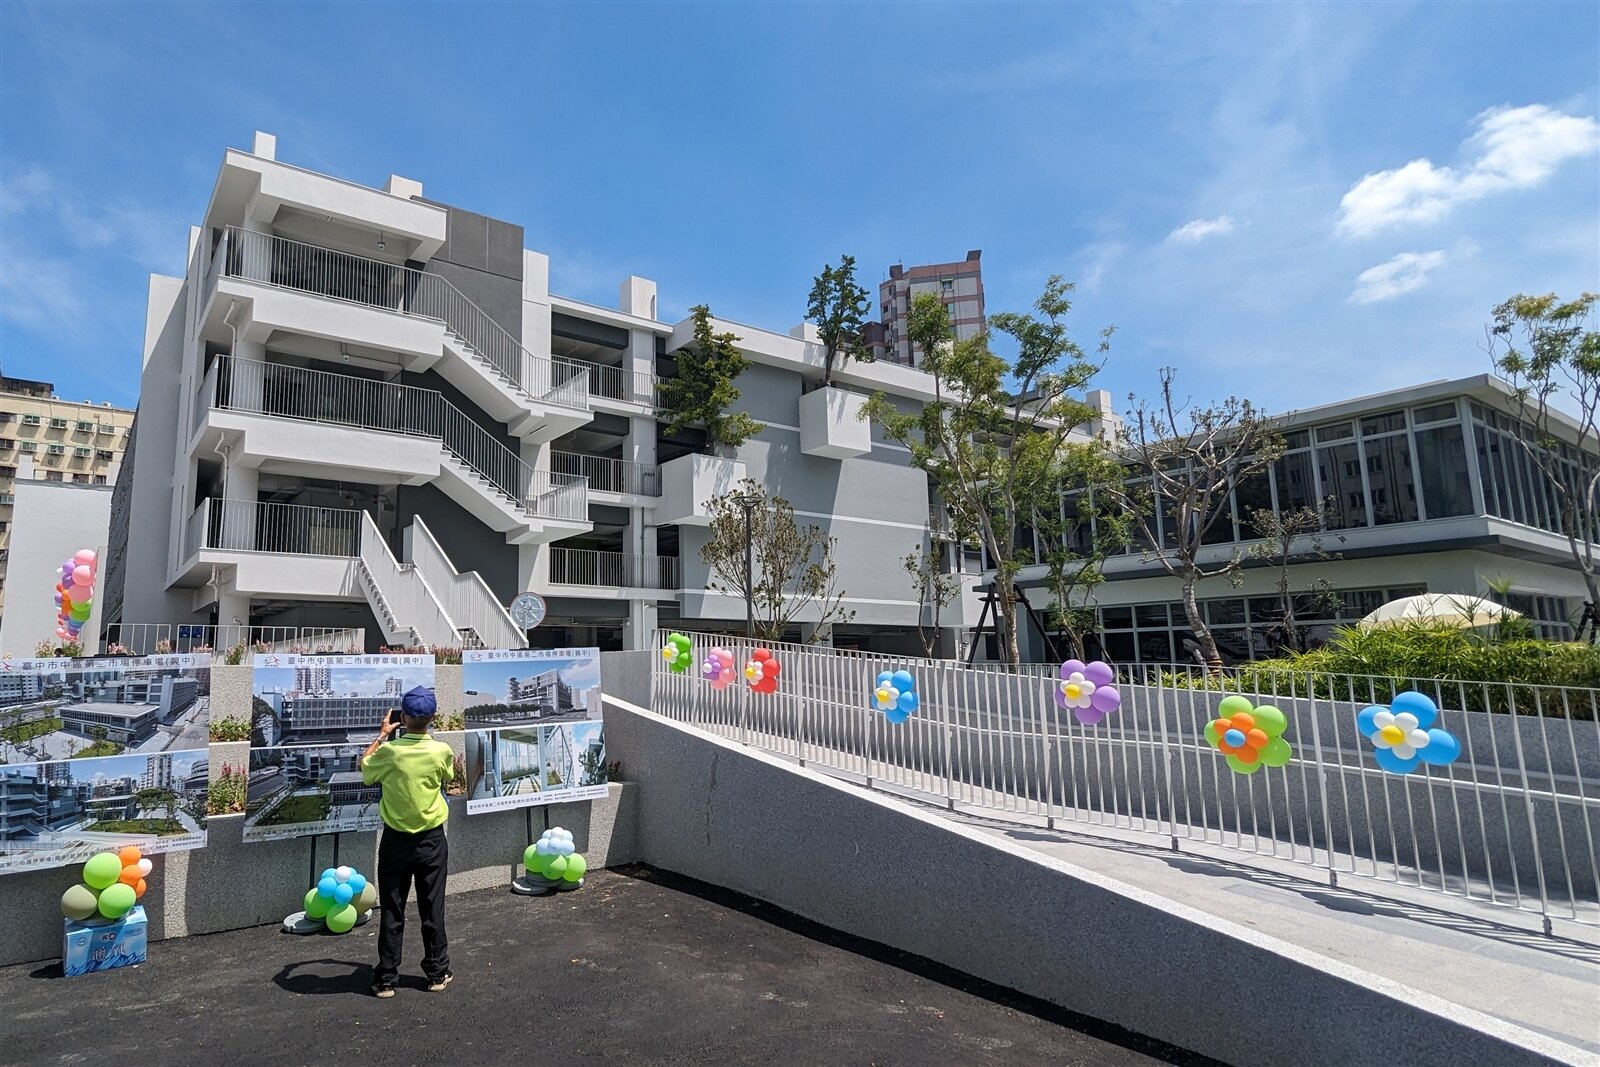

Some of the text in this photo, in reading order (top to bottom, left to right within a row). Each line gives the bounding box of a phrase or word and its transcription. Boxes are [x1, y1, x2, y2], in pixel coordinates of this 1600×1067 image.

[22, 657, 196, 671] 臺中市中區第二市場停車場(興中)
[287, 656, 423, 666] 臺中市中區第二市場停車場(興中)
